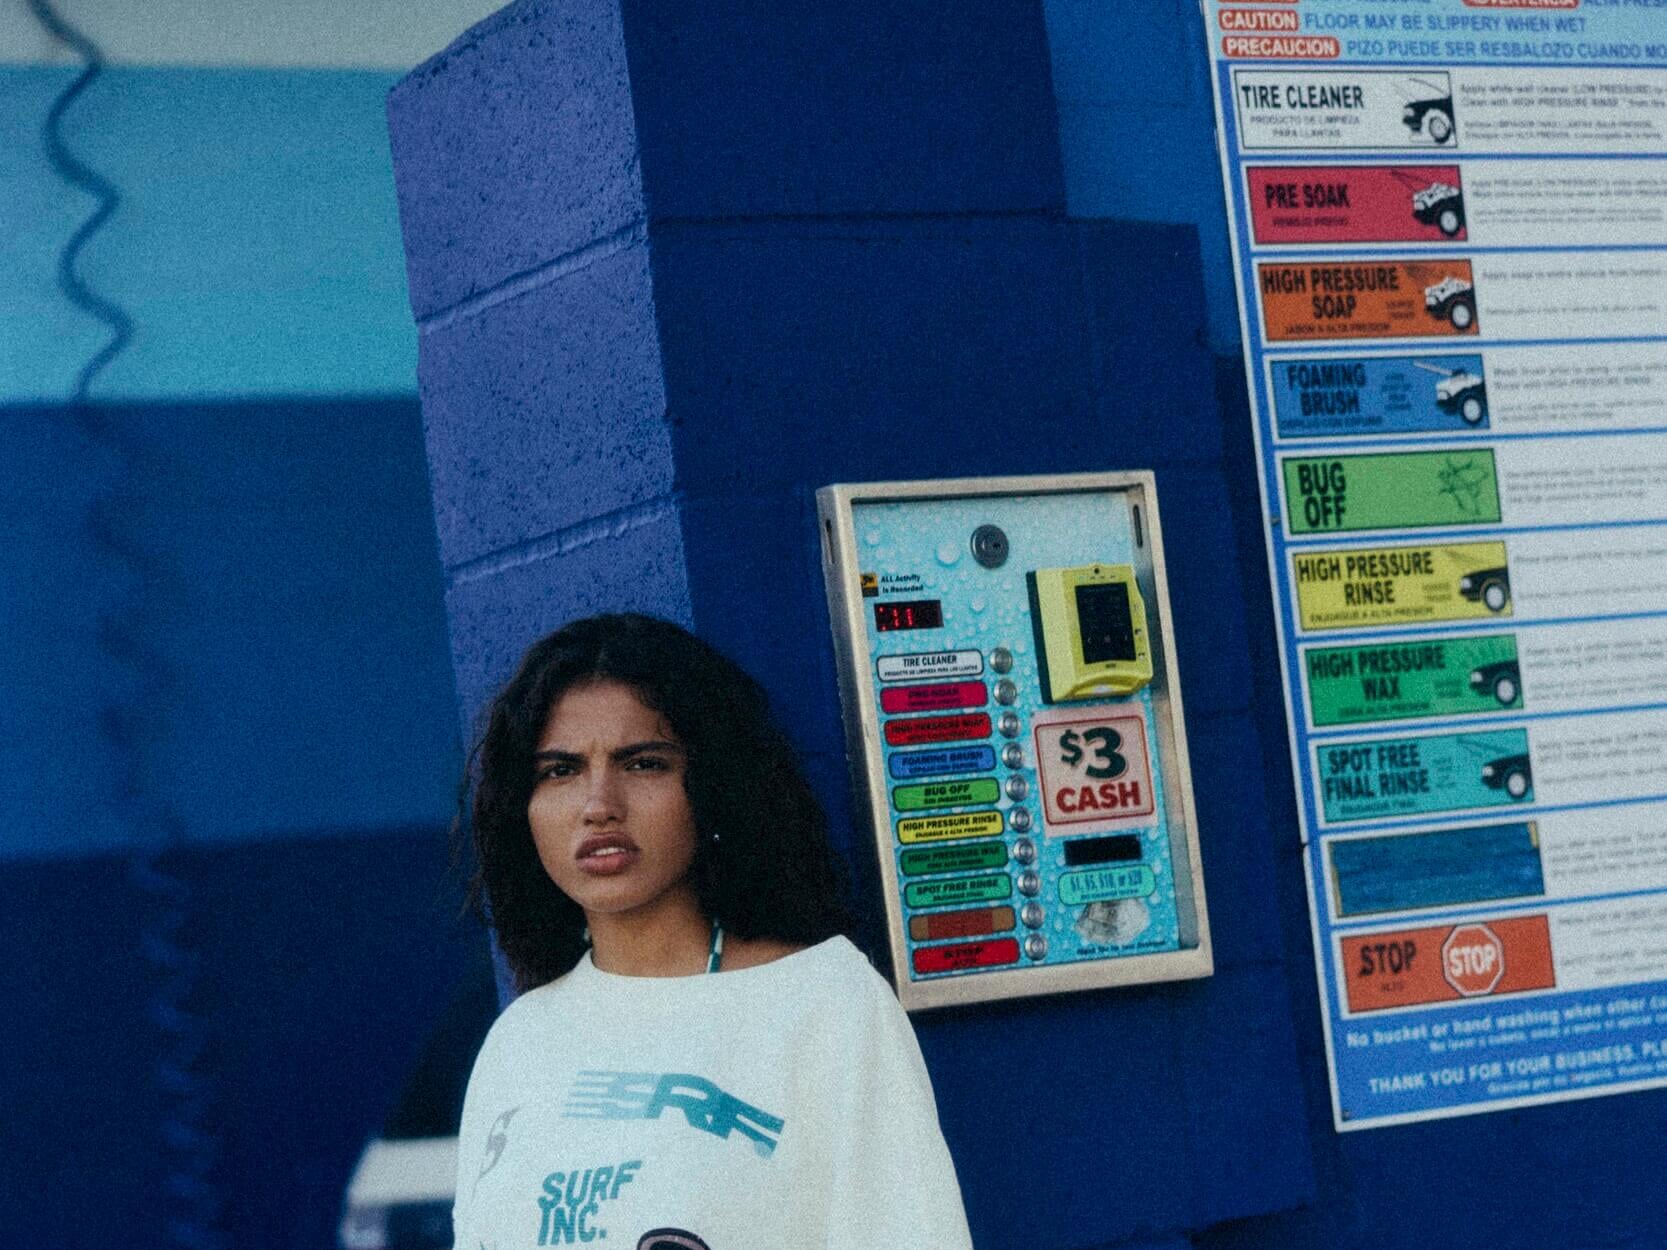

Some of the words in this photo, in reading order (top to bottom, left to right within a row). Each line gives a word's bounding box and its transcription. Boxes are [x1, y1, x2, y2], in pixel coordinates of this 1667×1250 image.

[1221, 11, 1297, 30] CAUTION
[1304, 13, 1361, 30] FLOOR
[1364, 14, 1397, 30] MAY
[1401, 15, 1424, 31] BE
[1427, 15, 1500, 32] SLIPPERY
[1504, 16, 1550, 32] WHEN
[1554, 17, 1587, 32] WET
[1226, 38, 1336, 56] PRECAUCION
[1346, 40, 1384, 56] PIZO
[1387, 41, 1441, 57] PUEDE
[1444, 41, 1477, 57] SER
[1576, 42, 1642, 58] CUANDO
[1241, 85, 1282, 109] TIRE
[1285, 85, 1365, 109] CLEANER
[1264, 184, 1299, 209] PRE
[1302, 183, 1350, 208] SOAK
[1262, 269, 1306, 294] HIGH
[1310, 267, 1399, 292] PRESSURE
[1312, 296, 1357, 319] SOAP
[1287, 363, 1367, 390] FOAMING
[1299, 390, 1360, 416] BRUSH
[1298, 462, 1347, 496] BUG
[1304, 495, 1346, 528] OFF
[1297, 557, 1342, 582] HIGH
[1345, 551, 1434, 578] PRESSURE
[1344, 580, 1396, 606] RINSE
[903, 657, 921, 668] TIRE
[922, 654, 957, 667] CLEANER
[1311, 652, 1353, 679] HIGH
[1358, 646, 1446, 673] PRESSURE
[1362, 676, 1400, 701] WAX
[1060, 727, 1127, 779] $3
[1327, 747, 1372, 774] SPOT
[1376, 744, 1421, 769] FREE
[924, 786, 946, 797] BUG
[948, 783, 971, 794] OFF
[1056, 781, 1141, 813] CASH
[1326, 774, 1375, 801] FINAL
[1379, 768, 1430, 797] RINSE
[903, 822, 925, 832] HIGH
[926, 817, 971, 829] PRESSURE
[972, 814, 997, 824] RINSE
[1359, 940, 1417, 977] STOP
[1450, 944, 1496, 978] STOP
[1346, 1031, 1369, 1048] No
[1373, 1023, 1428, 1044] bucket
[1431, 1023, 1449, 1038] or
[1452, 1016, 1492, 1034] hand
[1495, 1009, 1560, 1030] washing
[1563, 1004, 1602, 1020] when
[1369, 1072, 1425, 1094] THANK
[1430, 1067, 1465, 1087] YOU
[1469, 1062, 1502, 1081] FOR
[1505, 1055, 1551, 1076] YOUR
[537, 1159, 643, 1209] SURF
[537, 1202, 608, 1246] INC.
